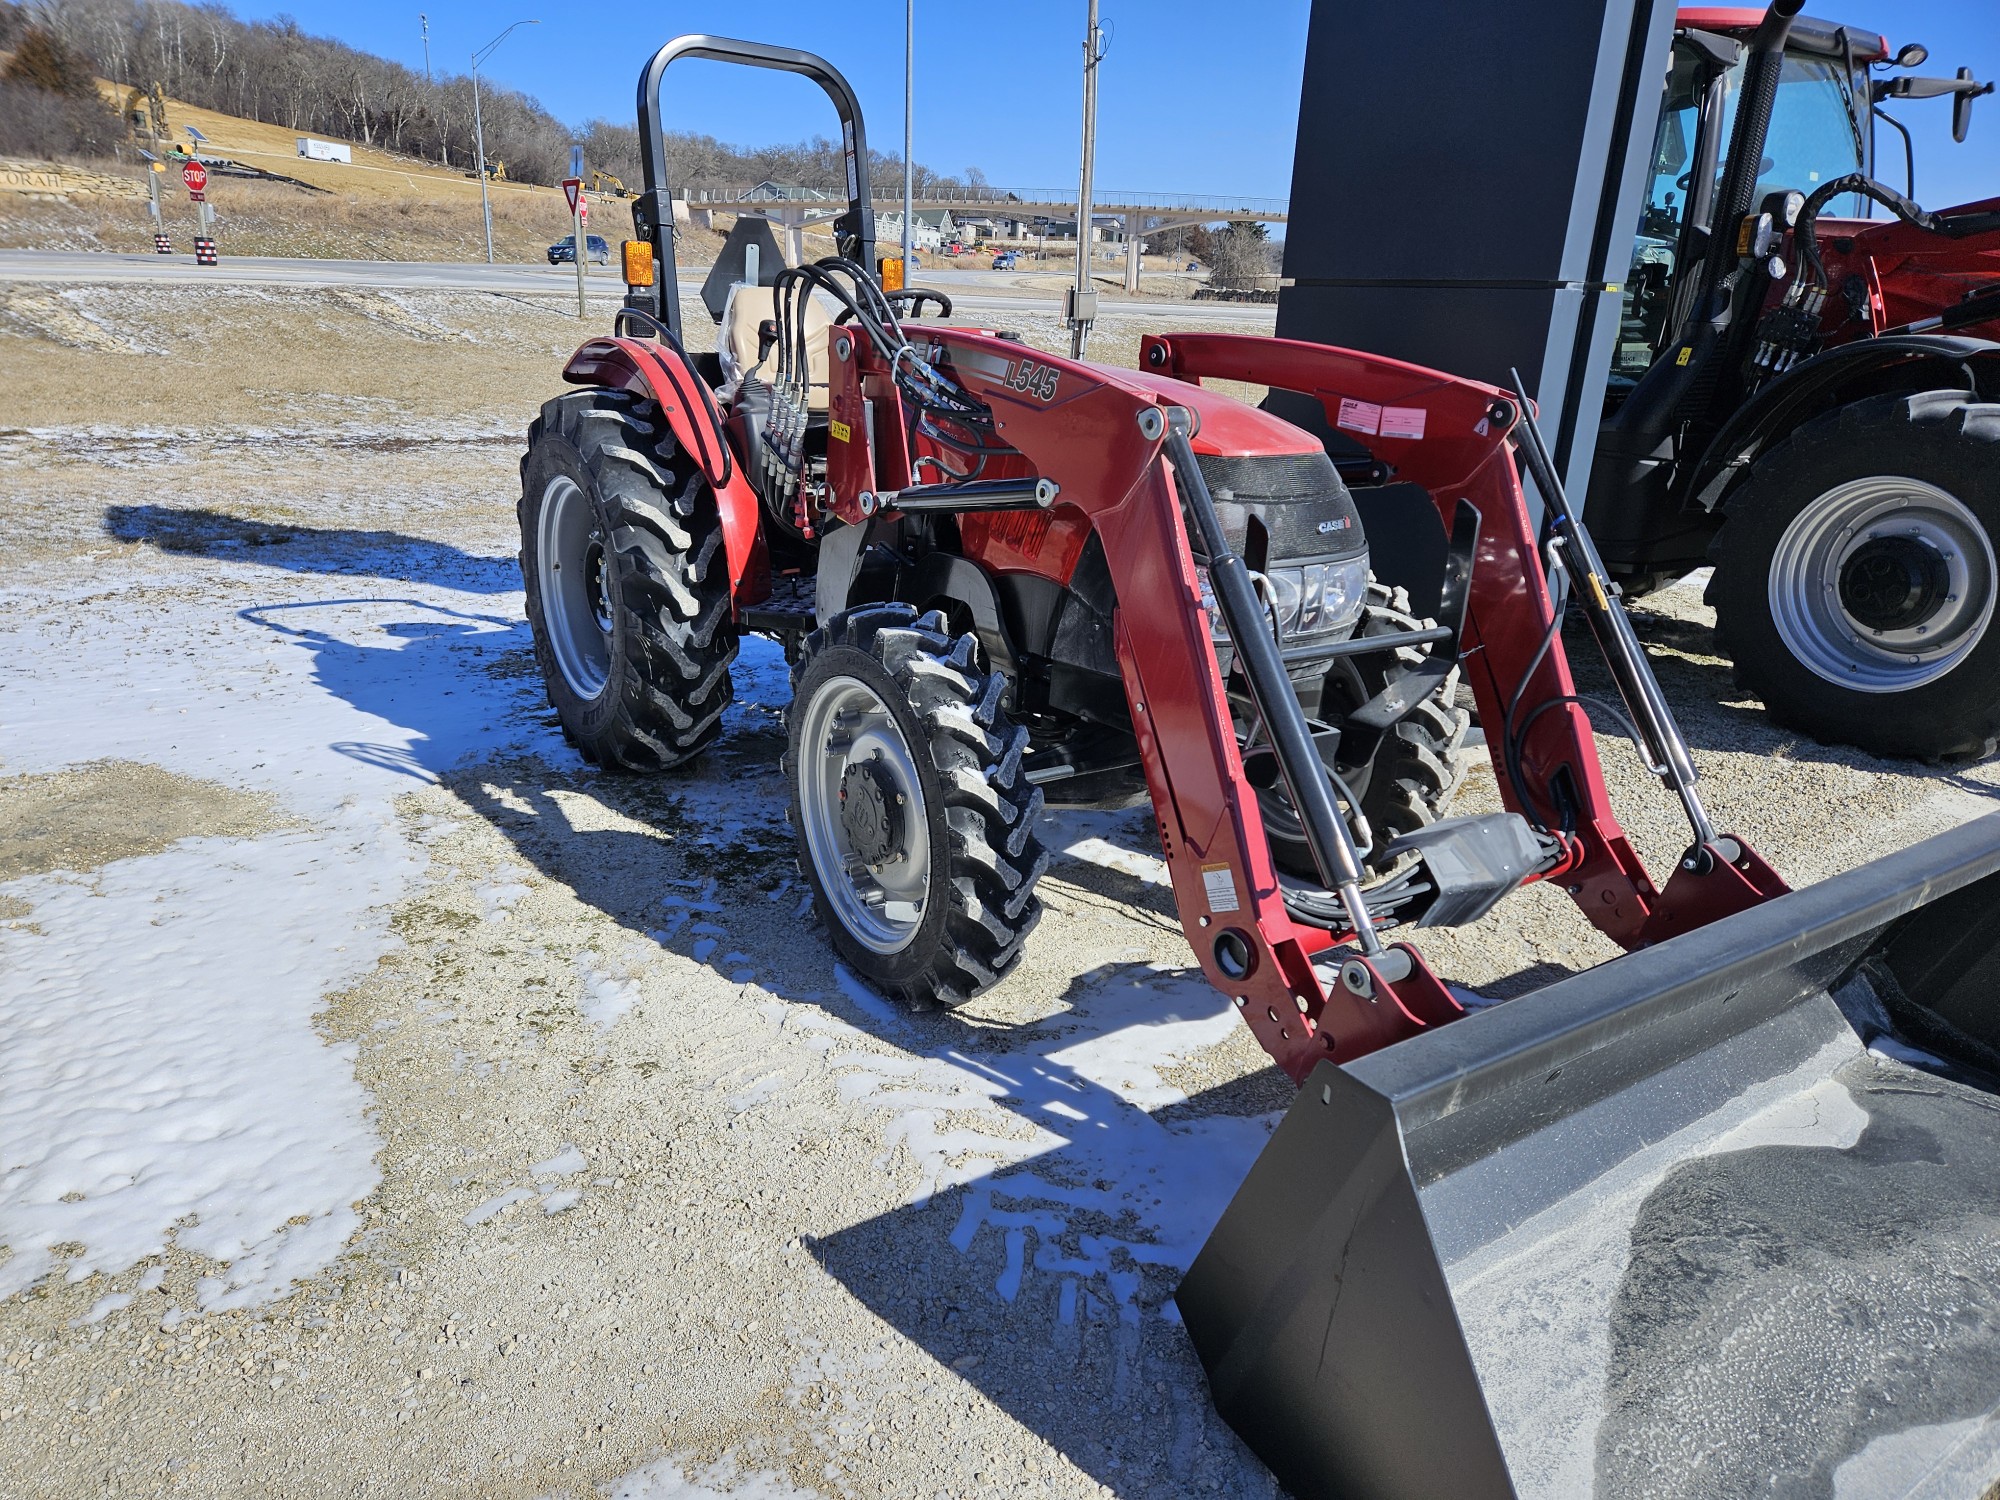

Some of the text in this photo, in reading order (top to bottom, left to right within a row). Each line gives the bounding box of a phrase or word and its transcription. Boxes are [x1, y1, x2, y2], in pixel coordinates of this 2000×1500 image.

[184, 169, 205, 182] STOP
[1004, 359, 1061, 402] L545
[1318, 519, 1345, 534] CASE
